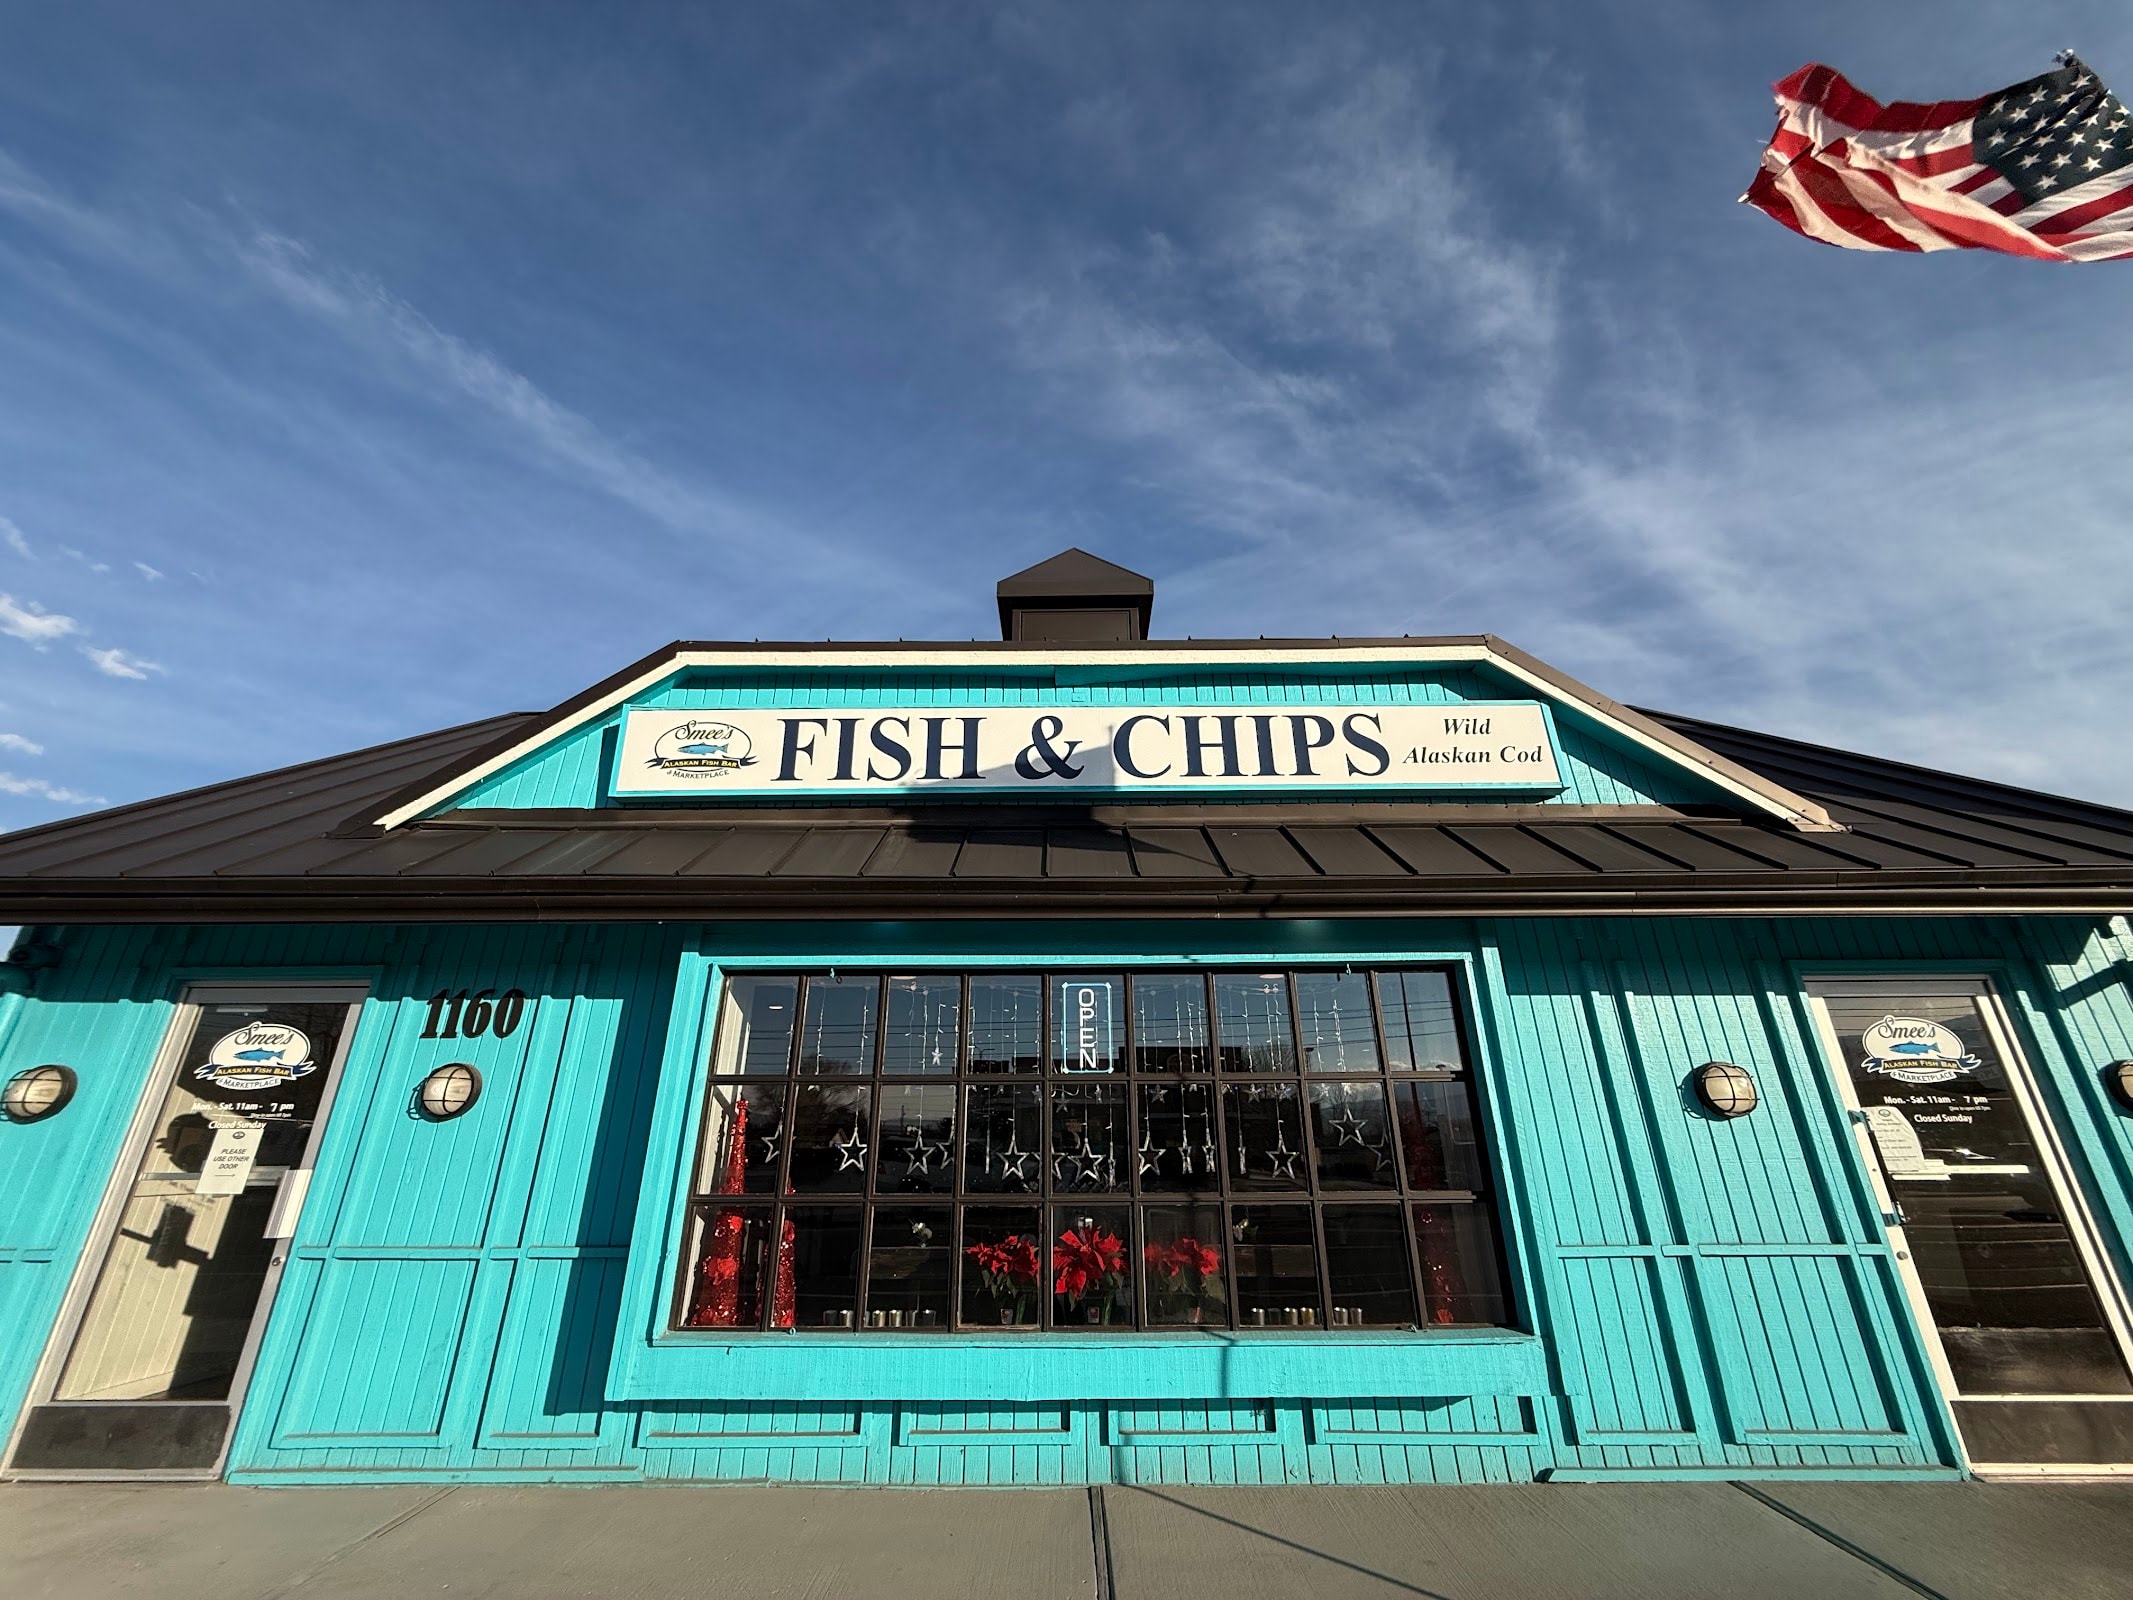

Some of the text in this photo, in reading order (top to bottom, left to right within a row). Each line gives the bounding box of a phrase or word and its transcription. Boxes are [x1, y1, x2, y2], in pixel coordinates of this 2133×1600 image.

[675, 720, 734, 740] Smee's
[1443, 718, 1492, 735] Wild
[771, 713, 1390, 782] FISH & CHIPS
[1402, 745, 1543, 764] Alaskan Cod
[664, 760, 699, 768] ALASKAN
[672, 769, 730, 779] MARKETPLACE
[418, 988, 526, 1039] 1160
[234, 1023, 295, 1046] Smee's
[1078, 988, 1097, 1069] OPEN
[1877, 1016, 1936, 1039] Smee's
[253, 1066, 273, 1074] FISH
[273, 1067, 290, 1075] BAR
[1884, 1061, 1919, 1069] ALASKAN
[1940, 1061, 1958, 1069] BAR
[1897, 1071, 1955, 1082] MARKETPLACE
[223, 1079, 279, 1089] MARKETPLACE
[208, 1121, 267, 1130] Closed Sunday
[1914, 1114, 1973, 1124] Closed Sunday
